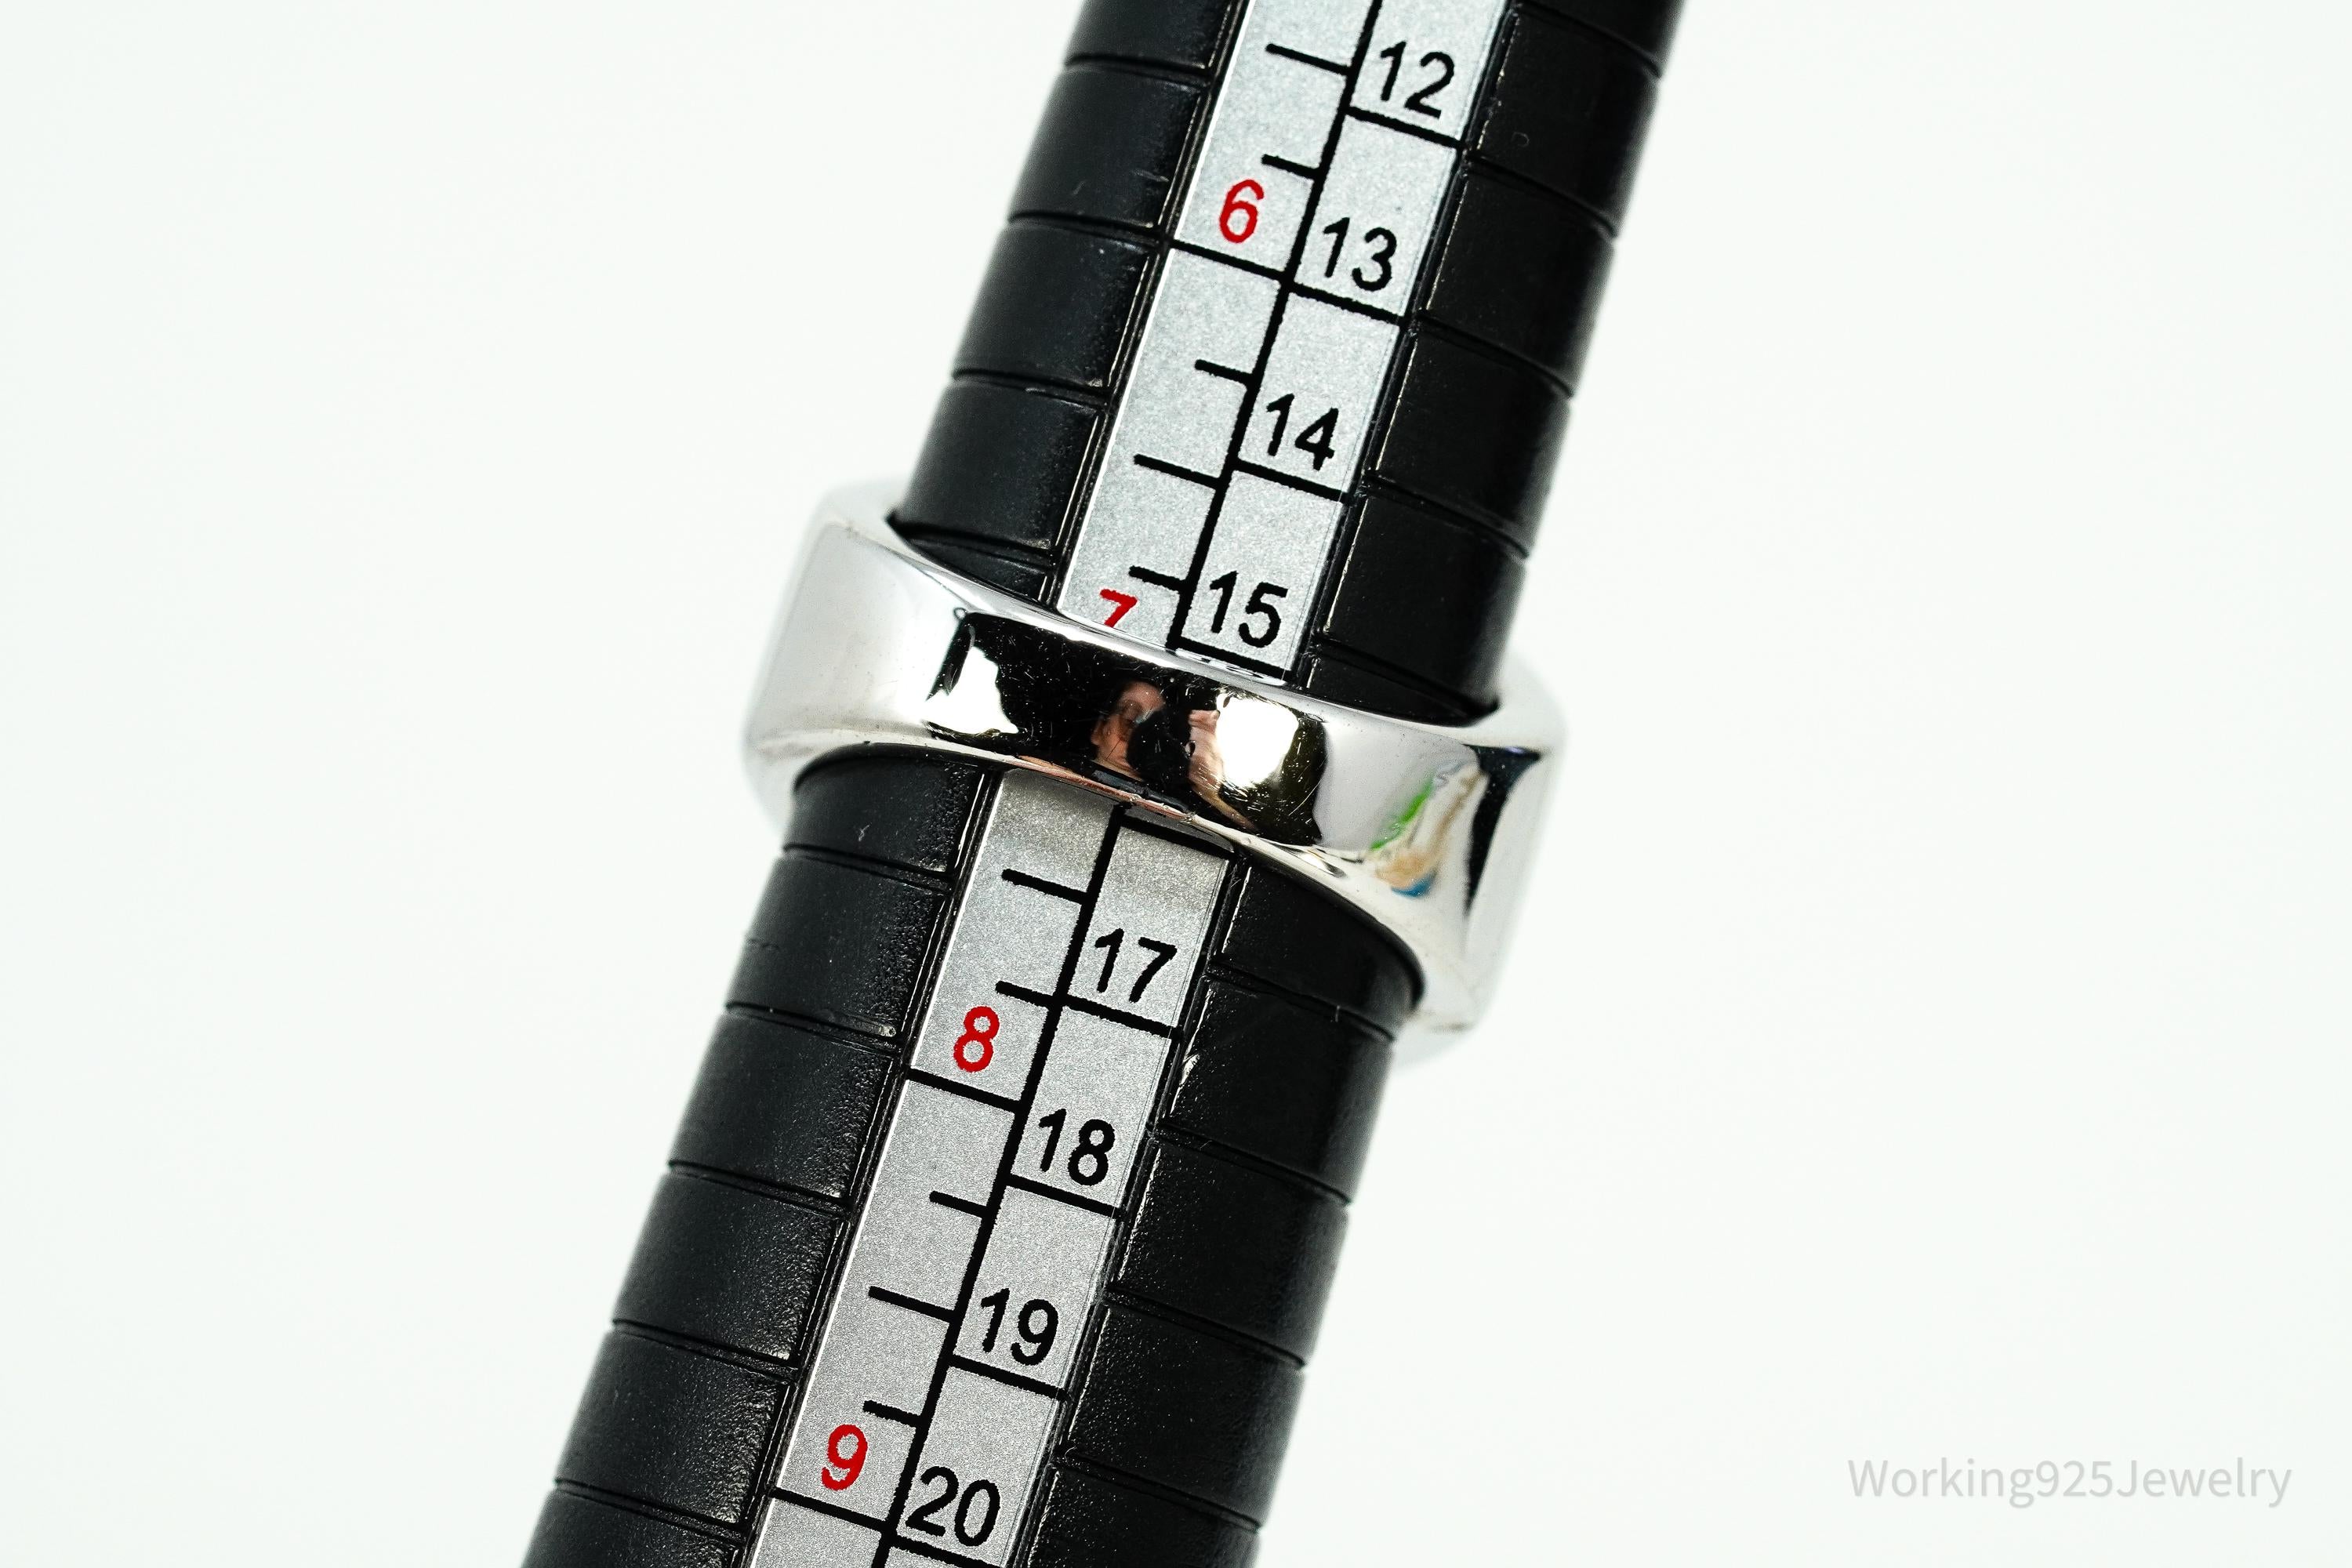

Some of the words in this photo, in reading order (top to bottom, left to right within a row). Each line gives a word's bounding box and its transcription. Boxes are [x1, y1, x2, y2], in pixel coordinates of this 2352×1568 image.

[1380, 41, 1455, 120] 12
[1218, 178, 1265, 244] 6
[1323, 216, 1398, 292] 13
[1265, 393, 1339, 472] 14
[1099, 588, 1138, 628] 7
[1209, 570, 1289, 648] 15
[1094, 927, 1178, 1004] 17
[953, 1005, 1000, 1073] 8
[1038, 1108, 1116, 1187] 18
[979, 1287, 1059, 1367] 19
[821, 1424, 869, 1491] 9
[904, 1465, 1001, 1548] 20
